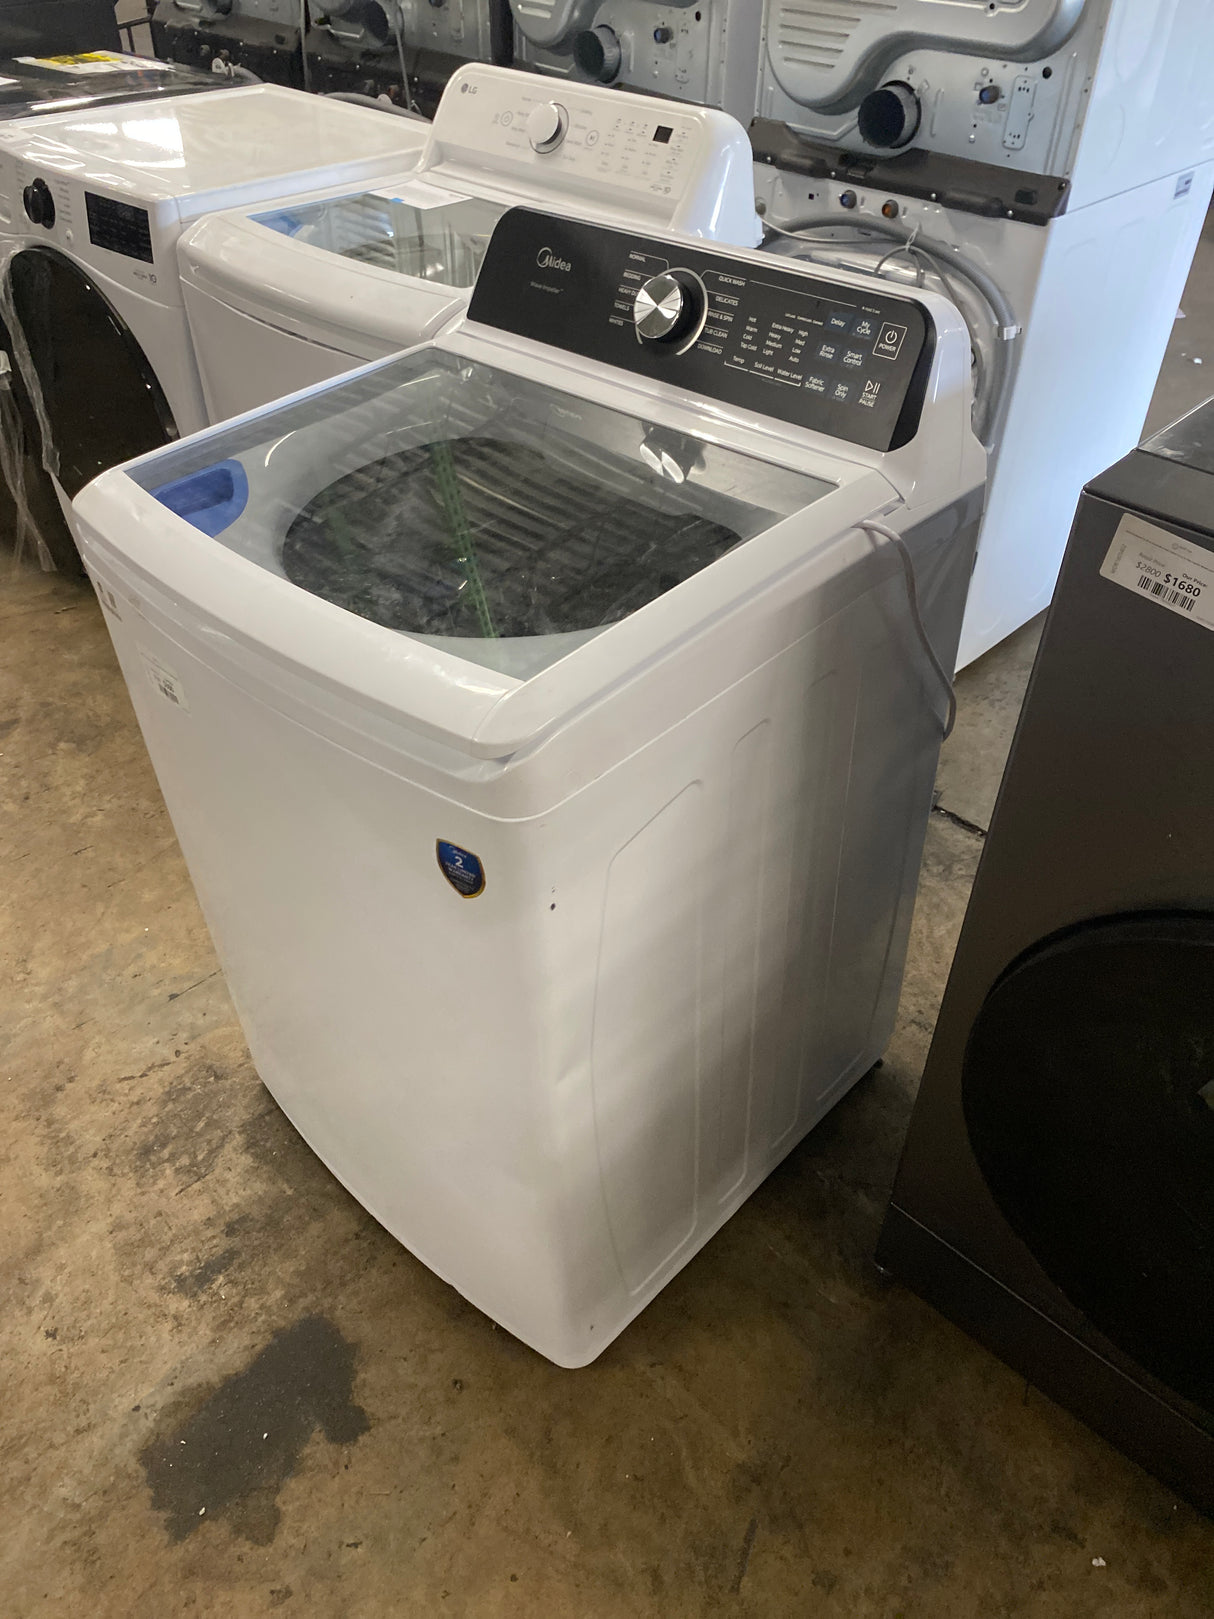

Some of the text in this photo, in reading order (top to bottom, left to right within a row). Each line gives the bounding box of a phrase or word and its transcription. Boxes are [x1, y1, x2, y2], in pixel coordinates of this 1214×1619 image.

[536, 247, 572, 272] Midea
[718, 276, 732, 284] QUICK
[715, 296, 739, 306] DELICATES
[830, 318, 846, 328] Delay
[713, 329, 728, 338] CLEAN
[856, 326, 871, 335] Cycle
[768, 332, 782, 340] Heavy
[697, 343, 722, 354] DOWNLOAD
[765, 340, 783, 348] Medium
[822, 344, 836, 353] Extra
[878, 342, 897, 352] POWER
[819, 350, 834, 359] Rinse
[847, 350, 863, 360] Smart
[733, 356, 745, 364] Temp
[843, 357, 862, 366] Control
[777, 368, 790, 377] Water
[809, 376, 824, 386] Fabric
[805, 381, 825, 392] Softener
[837, 383, 849, 392] Spin
[834, 390, 847, 398] Only
[862, 392, 877, 400] START
[859, 398, 875, 408] PAUSE
[1136, 561, 1201, 597] $2800 $1680
[454, 856, 464, 868] 2
